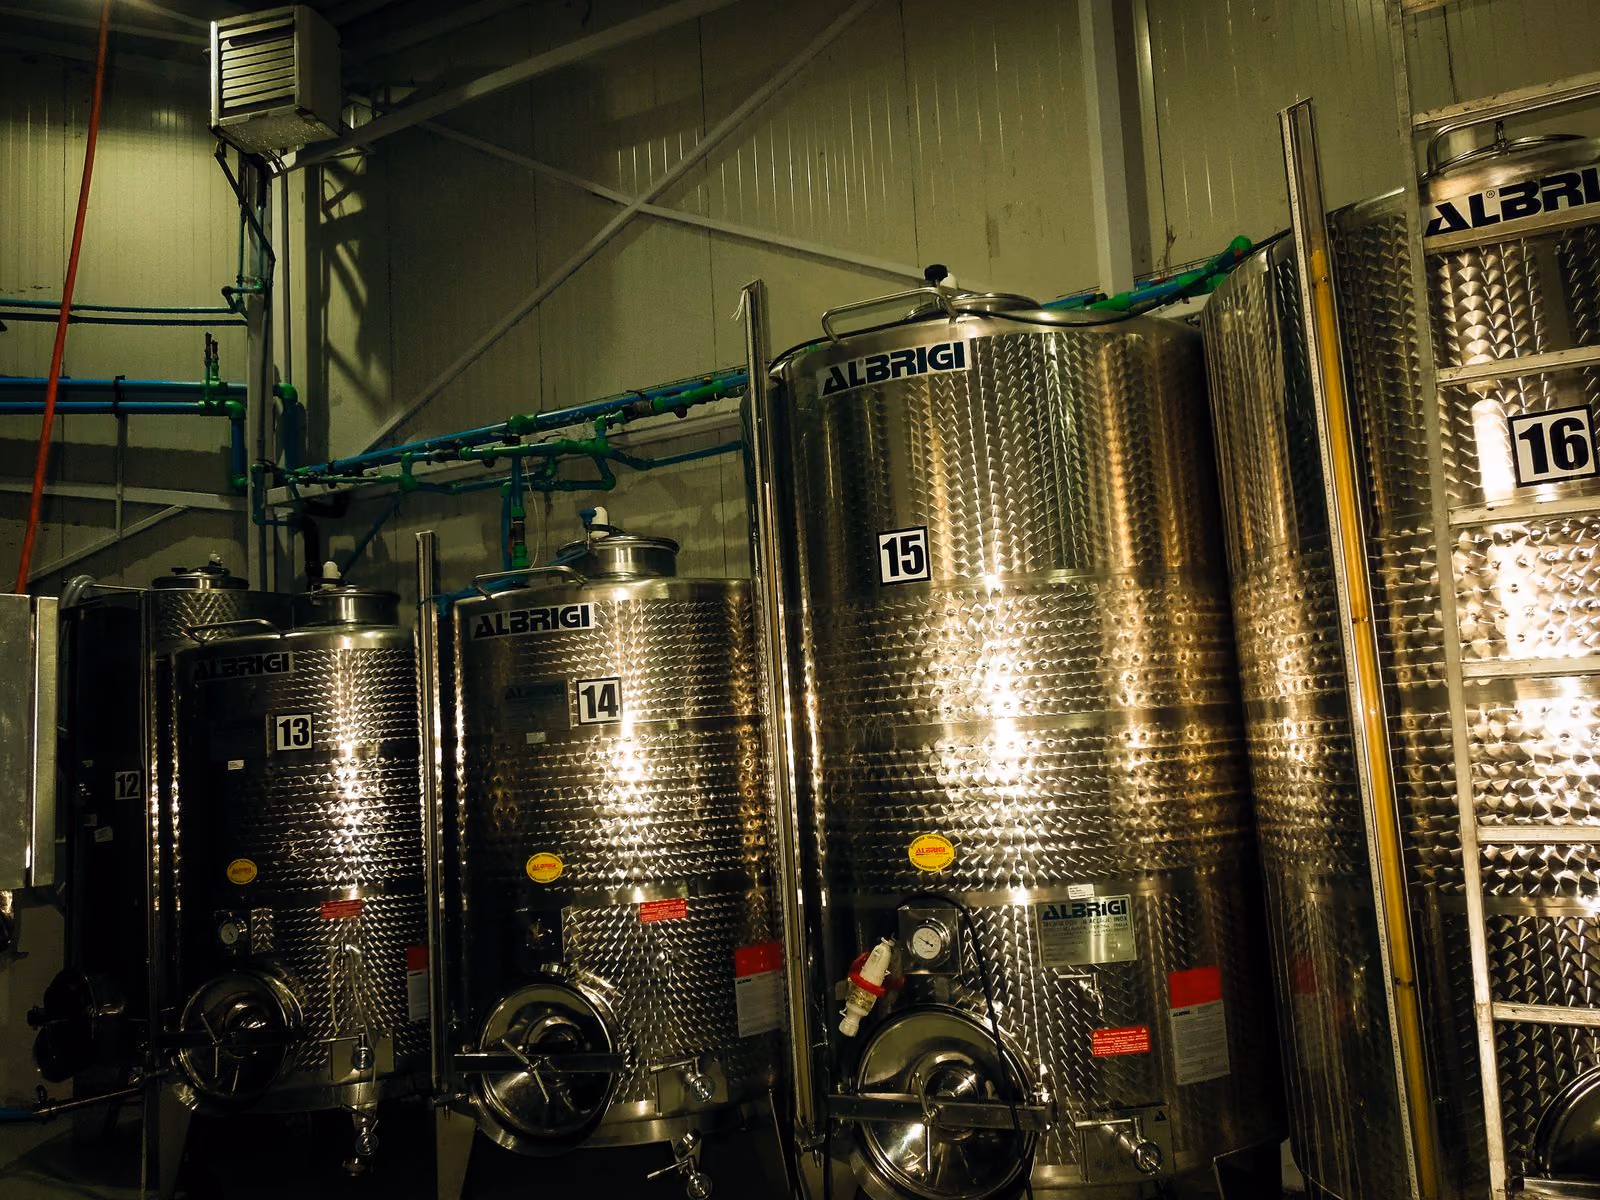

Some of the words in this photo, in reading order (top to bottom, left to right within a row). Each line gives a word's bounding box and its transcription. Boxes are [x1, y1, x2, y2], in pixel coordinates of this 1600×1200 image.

[822, 341, 966, 397] ALBRIGI
[1519, 417, 1589, 476] 16
[882, 534, 925, 578] 15
[474, 604, 591, 640] ALBRIGI
[195, 653, 290, 680] ALBRIGI
[580, 683, 619, 719] 14
[278, 717, 310, 747] 13
[117, 773, 139, 798] 12
[1042, 899, 1127, 921] ALBRIGI
